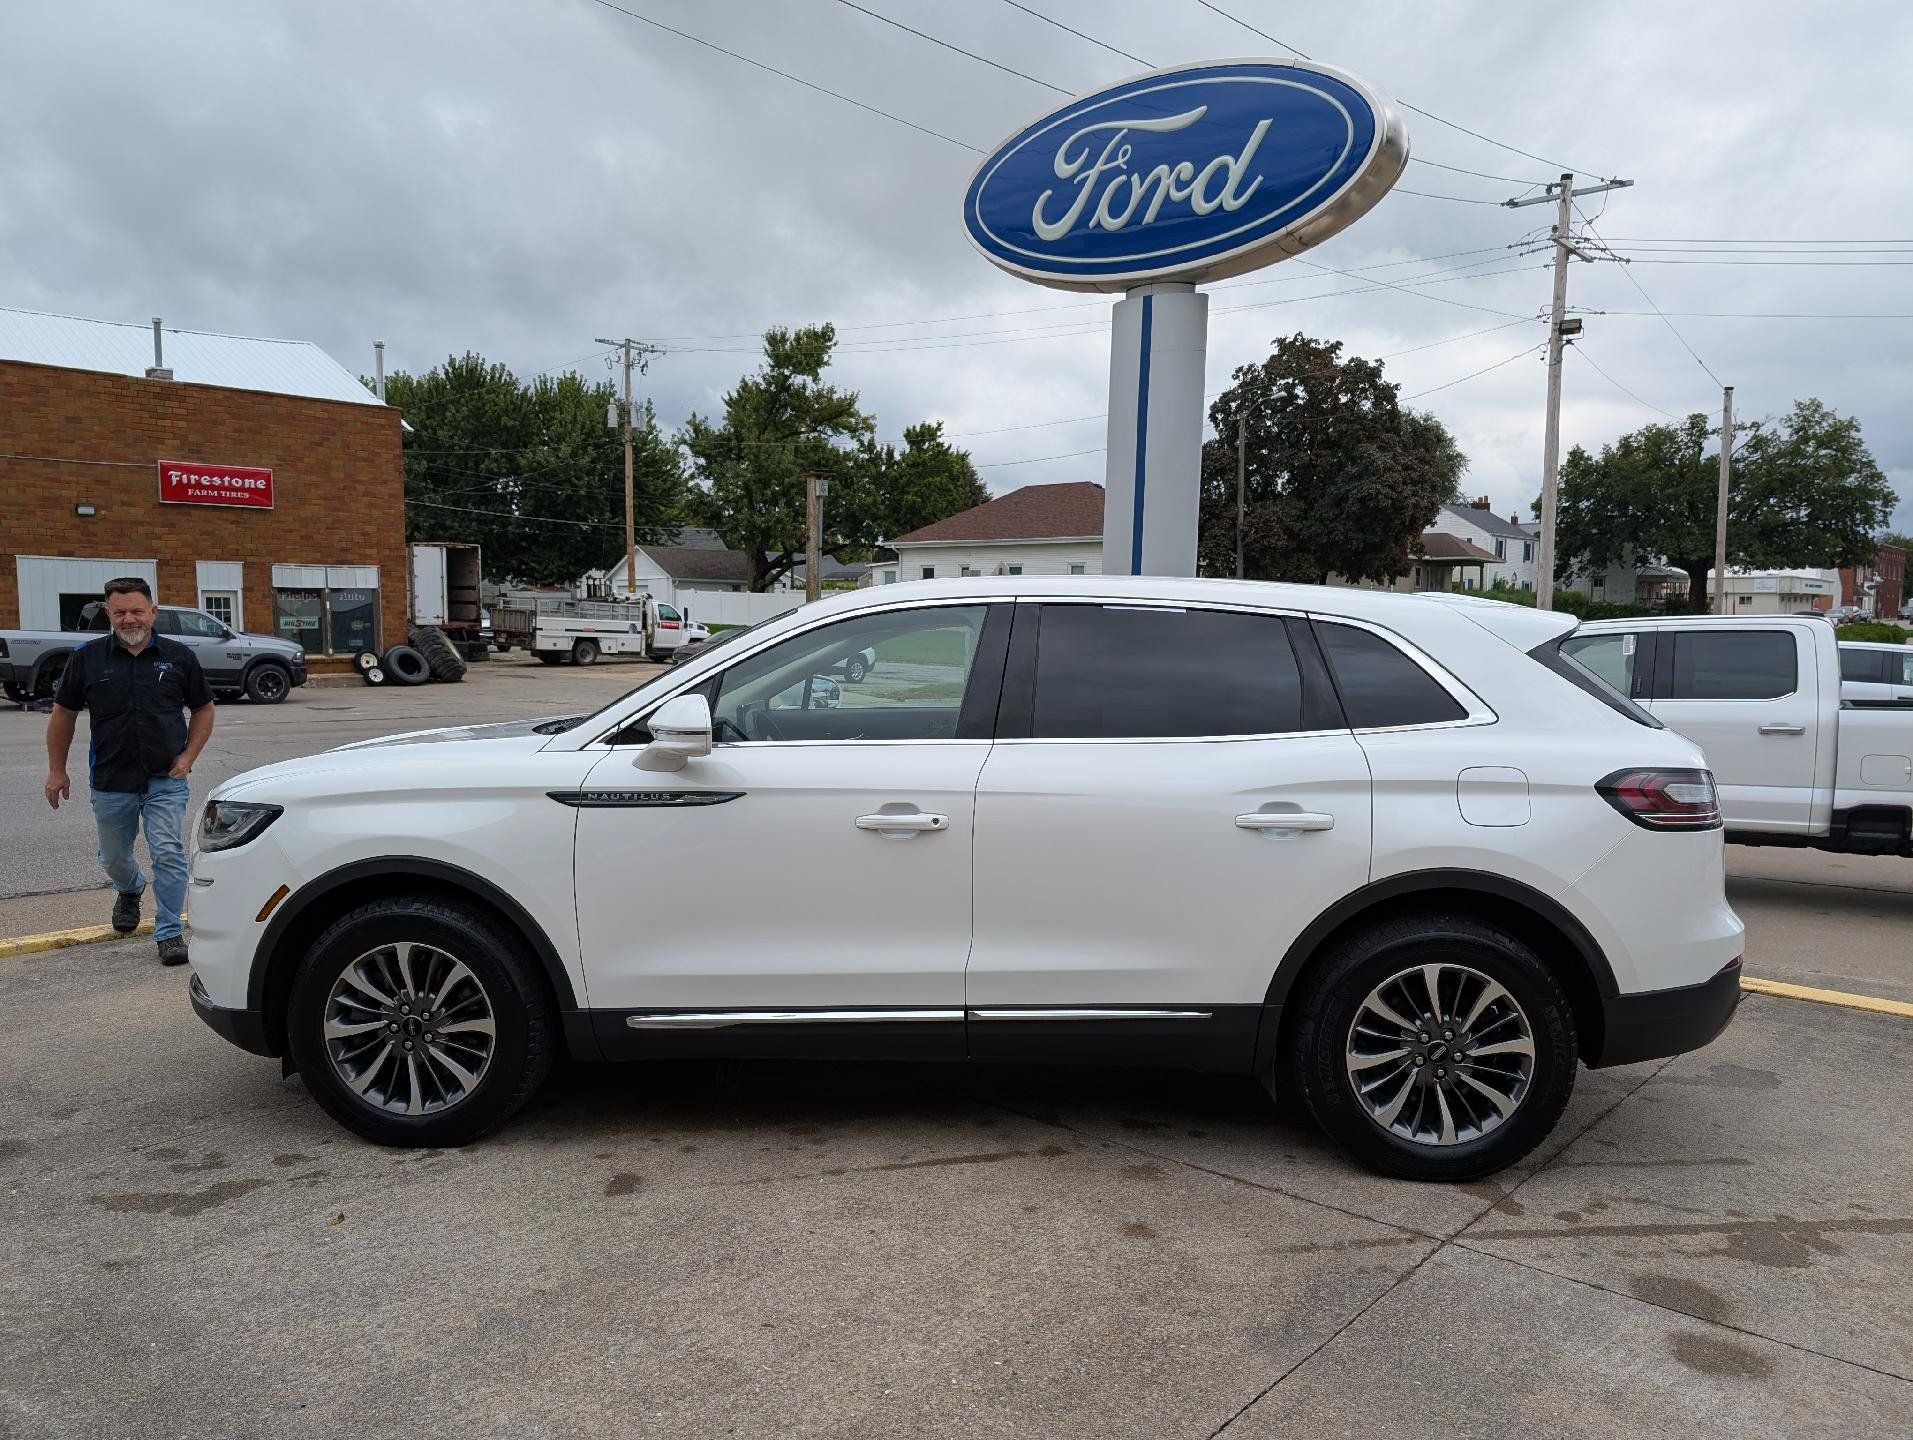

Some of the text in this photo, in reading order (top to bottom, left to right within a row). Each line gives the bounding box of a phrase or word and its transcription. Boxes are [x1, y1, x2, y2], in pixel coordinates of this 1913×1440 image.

[1032, 105, 1274, 241] Ford
[167, 470, 267, 489] Firestone
[187, 488, 250, 499] FARM TIRES
[586, 792, 671, 801] NAUTILUS
